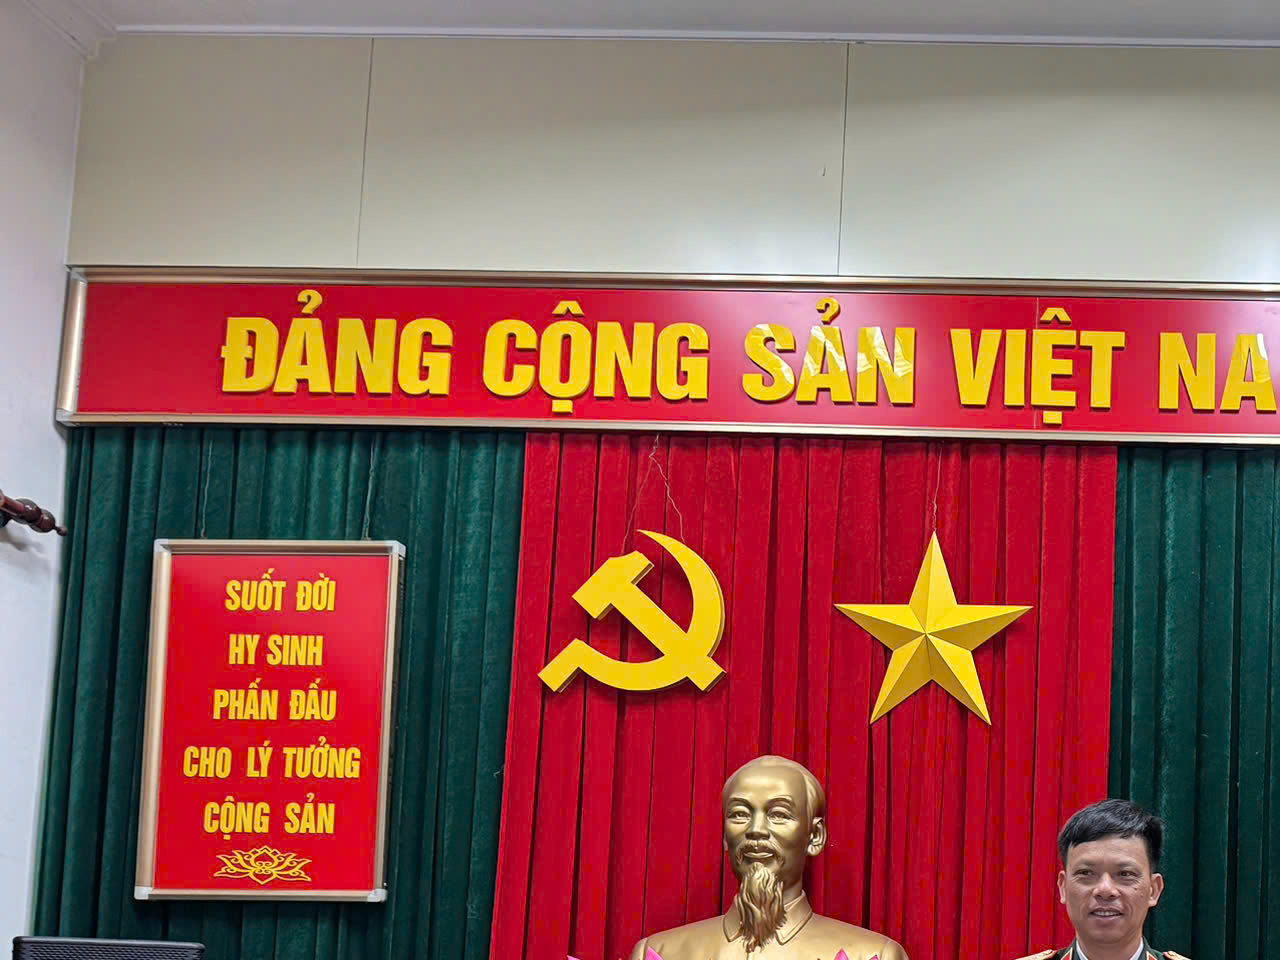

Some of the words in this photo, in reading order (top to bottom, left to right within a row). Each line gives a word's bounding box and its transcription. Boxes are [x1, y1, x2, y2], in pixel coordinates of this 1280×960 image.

[220, 288, 453, 395] ĐẢNG
[482, 300, 708, 413] CỘNG
[742, 296, 917, 405] SẢN
[950, 306, 1126, 425] VIỆT
[225, 567, 287, 612] SUỐT
[295, 572, 337, 612] ĐỜI
[228, 633, 261, 666] HY
[266, 634, 324, 666] SINH
[212, 677, 279, 722] PHẤN
[289, 677, 337, 722] ĐẤU
[183, 745, 233, 779] CHO
[246, 740, 273, 779] LÝ
[282, 735, 361, 780] TƯỞNG
[203, 795, 271, 840] CỘNG
[284, 792, 336, 835] SẢN
